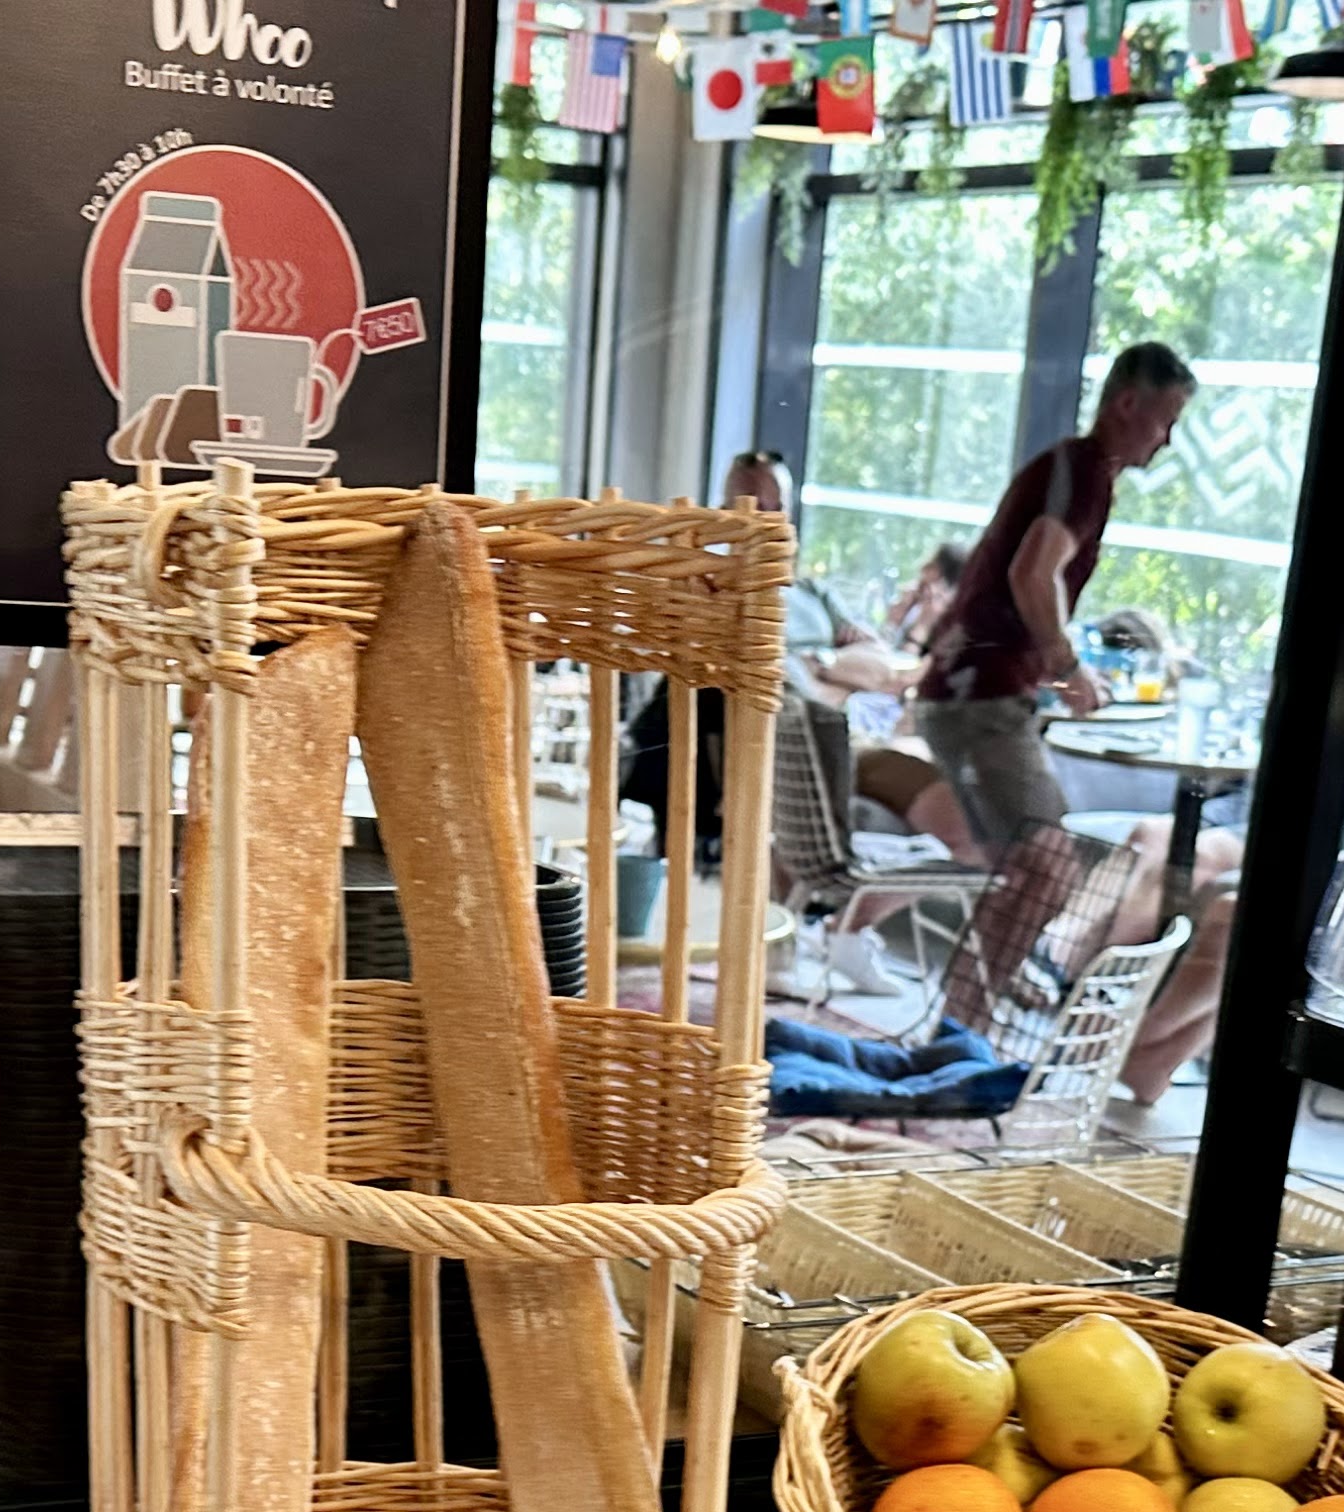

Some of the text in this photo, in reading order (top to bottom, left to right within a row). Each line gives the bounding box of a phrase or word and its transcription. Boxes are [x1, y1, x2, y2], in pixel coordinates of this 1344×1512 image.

[152, 0, 313, 68] Whoo
[124, 60, 335, 109] Buffet à volonté
[80, 195, 106, 222] De
[96, 152, 142, 194] 7h30
